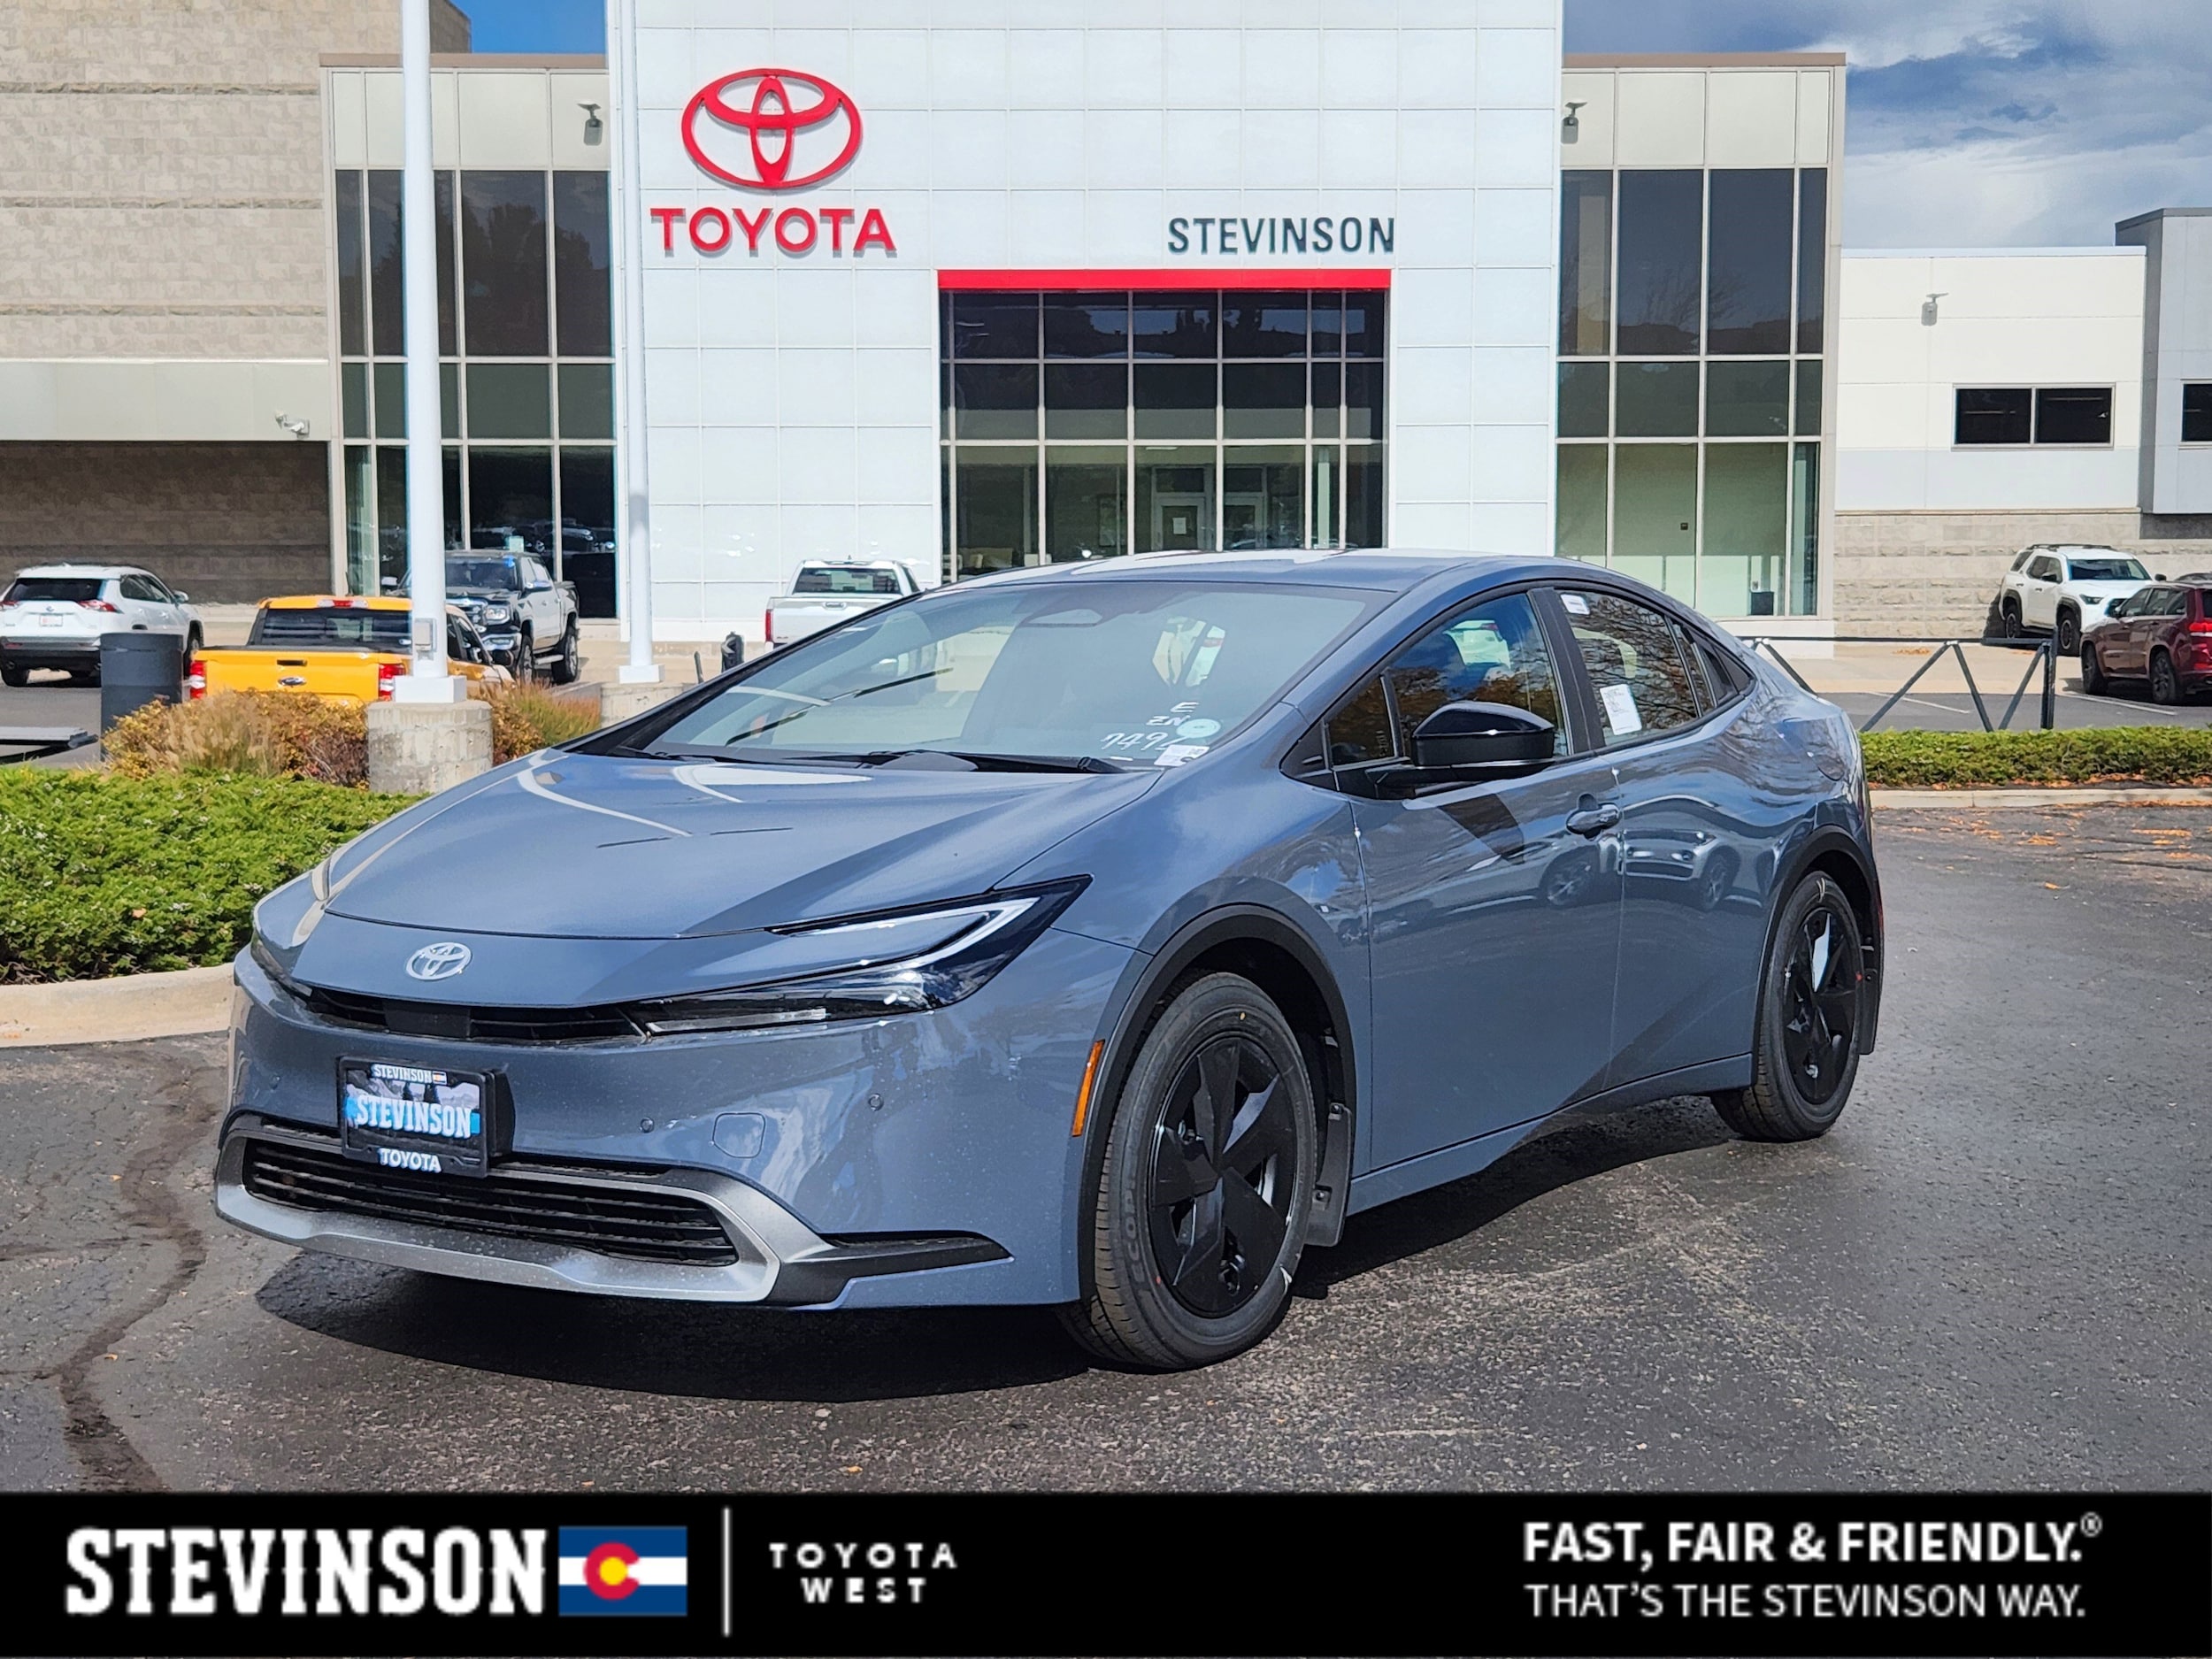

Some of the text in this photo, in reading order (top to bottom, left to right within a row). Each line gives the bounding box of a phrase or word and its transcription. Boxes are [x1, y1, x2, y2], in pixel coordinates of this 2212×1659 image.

[650, 207, 895, 255] TOYOTA
[1168, 217, 1394, 254] STEVINSON
[371, 1064, 433, 1084] STEVINSON
[356, 1094, 472, 1139] STEVINSON
[378, 1148, 442, 1173] TOYOTA
